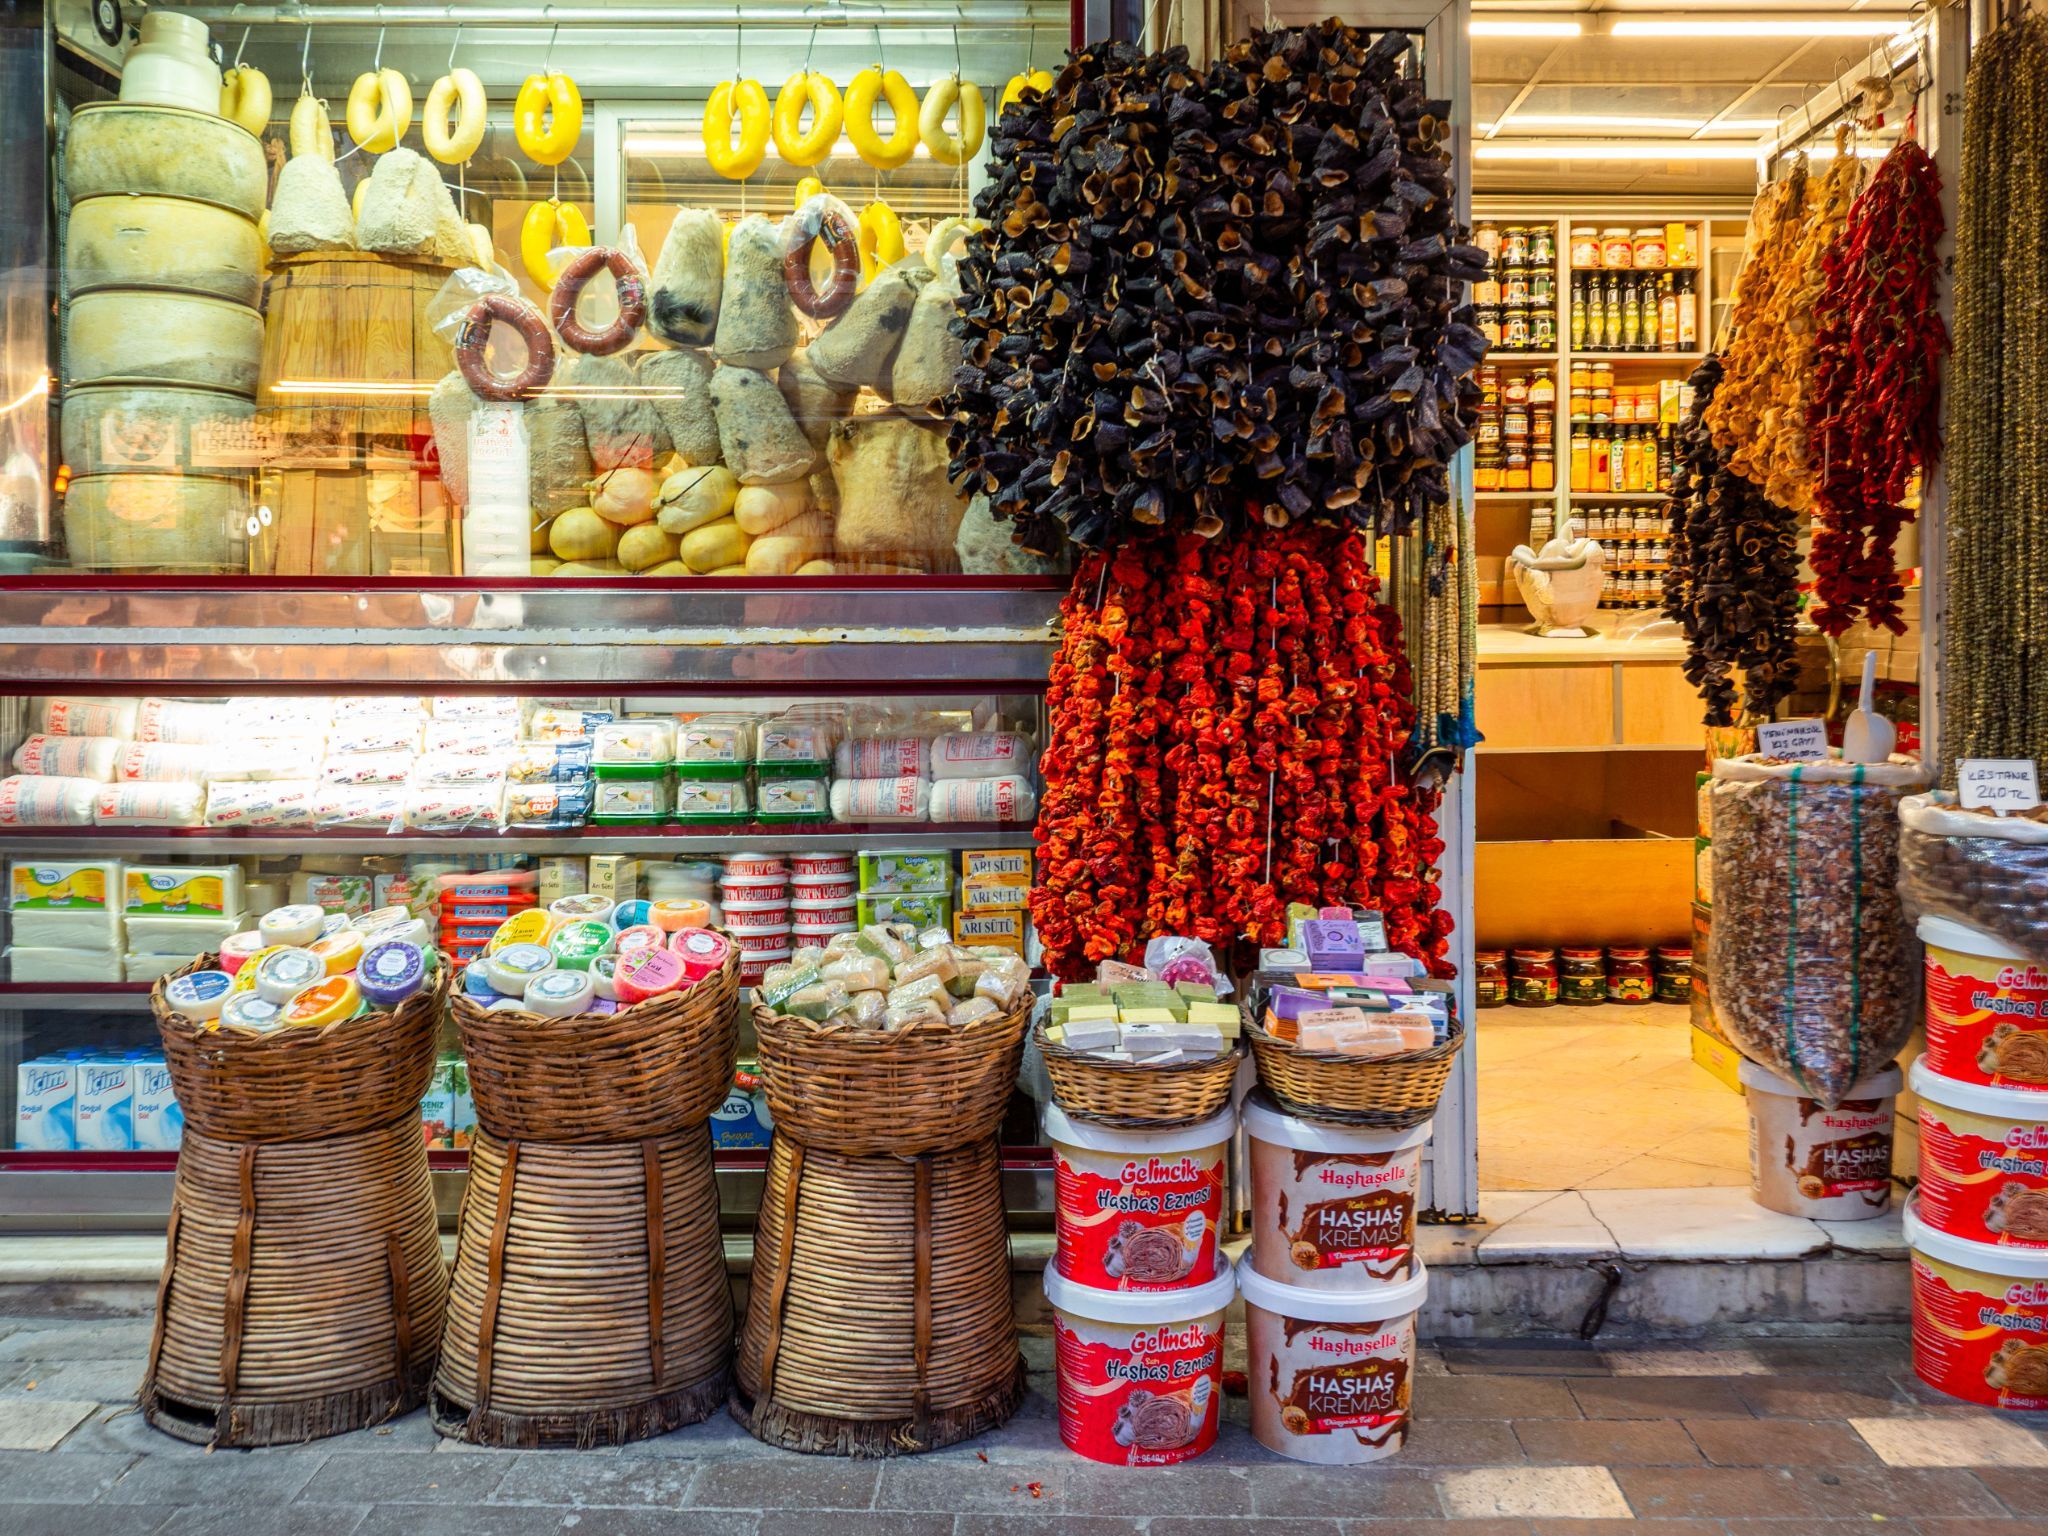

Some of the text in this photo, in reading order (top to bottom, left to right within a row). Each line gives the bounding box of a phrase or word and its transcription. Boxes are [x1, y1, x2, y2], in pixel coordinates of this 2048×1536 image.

[1967, 769, 2031, 781] KESTANE
[972, 858, 1022, 873] ARI SÜTÜ
[970, 891, 990, 904] ARI
[962, 919, 1013, 935] ARI SÜTÜ
[1972, 991, 2037, 1017] Haşhaş
[1120, 1158, 1199, 1185] Gelincik
[1979, 1151, 2043, 1176] Haşhaş
[1318, 1166, 1405, 1189] Haşhaşella
[1097, 1189, 1159, 1215] Haşhaş
[1164, 1183, 1212, 1211] Ezmesi
[1319, 1204, 1404, 1232] HAŞHAŞ
[1319, 1225, 1401, 1248] KREMASI
[1980, 1307, 2042, 1333] Haşhaş
[1131, 1324, 1205, 1355] Gelincik
[1308, 1333, 1397, 1357] Haşhaşella
[1106, 1346, 1217, 1383] Haşhaş Ezmesi
[1309, 1372, 1395, 1400] HAŞHAŞ
[1308, 1391, 1394, 1415] KREMASI
